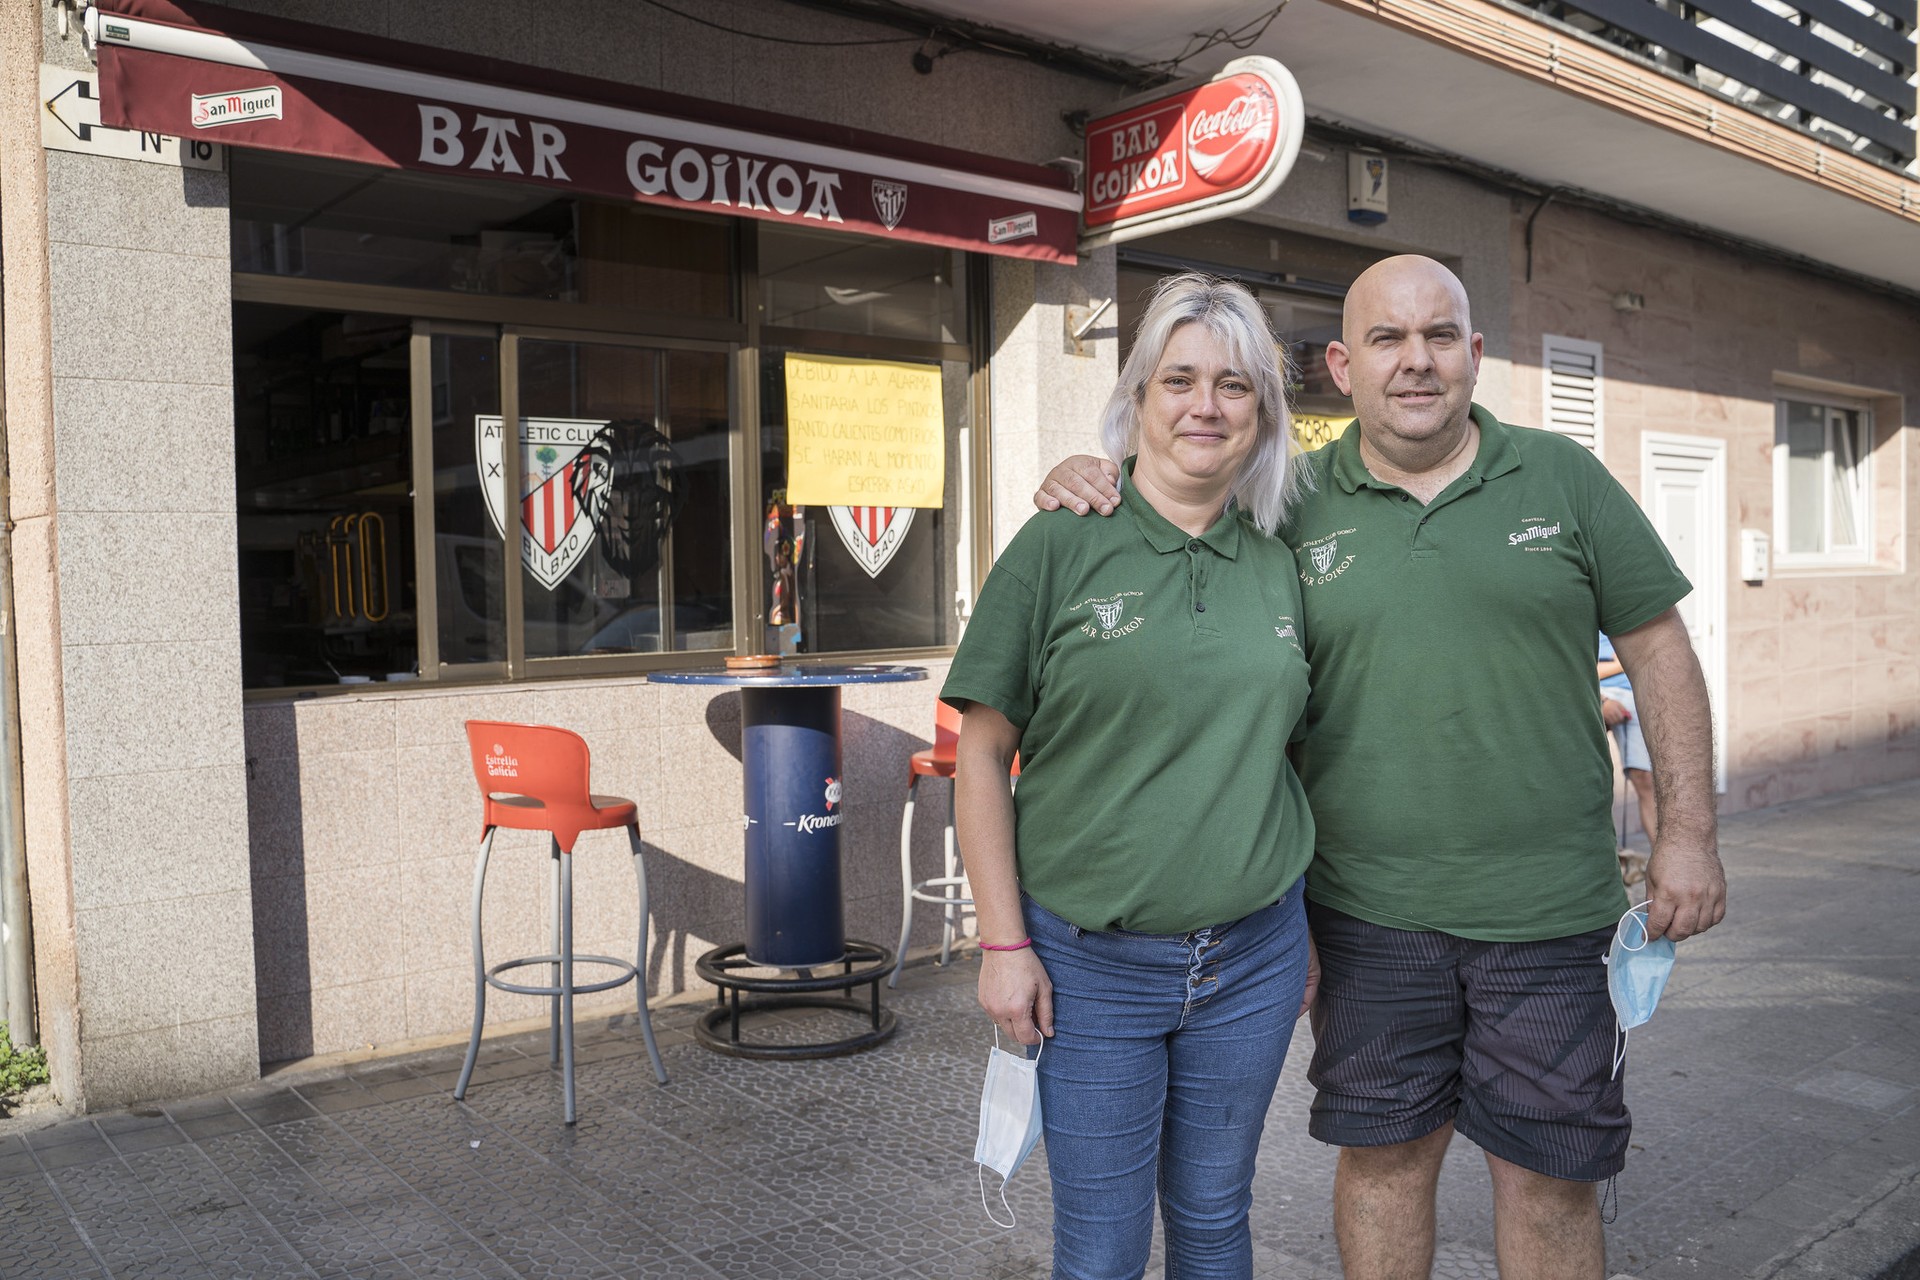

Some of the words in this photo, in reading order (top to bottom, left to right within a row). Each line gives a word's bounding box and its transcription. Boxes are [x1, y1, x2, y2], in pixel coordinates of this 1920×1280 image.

[417, 103, 573, 182] BAR
[1111, 120, 1160, 163] BAR
[789, 360, 839, 383] DEBIDO
[848, 367, 860, 385] A
[864, 369, 881, 388] LA
[887, 371, 933, 392] ALARMA
[790, 391, 860, 413] SANITARIA
[867, 397, 889, 415] LOS
[565, 428, 603, 442] CLU
[790, 418, 829, 439] TANTO
[832, 422, 882, 442] CALIENTES
[793, 444, 814, 465] SE
[823, 448, 863, 468] HARAN
[867, 450, 881, 469] AL
[887, 451, 938, 471] MOMENTO
[523, 534, 578, 576] BILBAO
[853, 529, 895, 565] BILBAO
[1317, 554, 1357, 585] GOIKOA
[1101, 616, 1145, 640] GOIKOA
[485, 754, 519, 766] Estrella
[487, 765, 518, 777] Galicia
